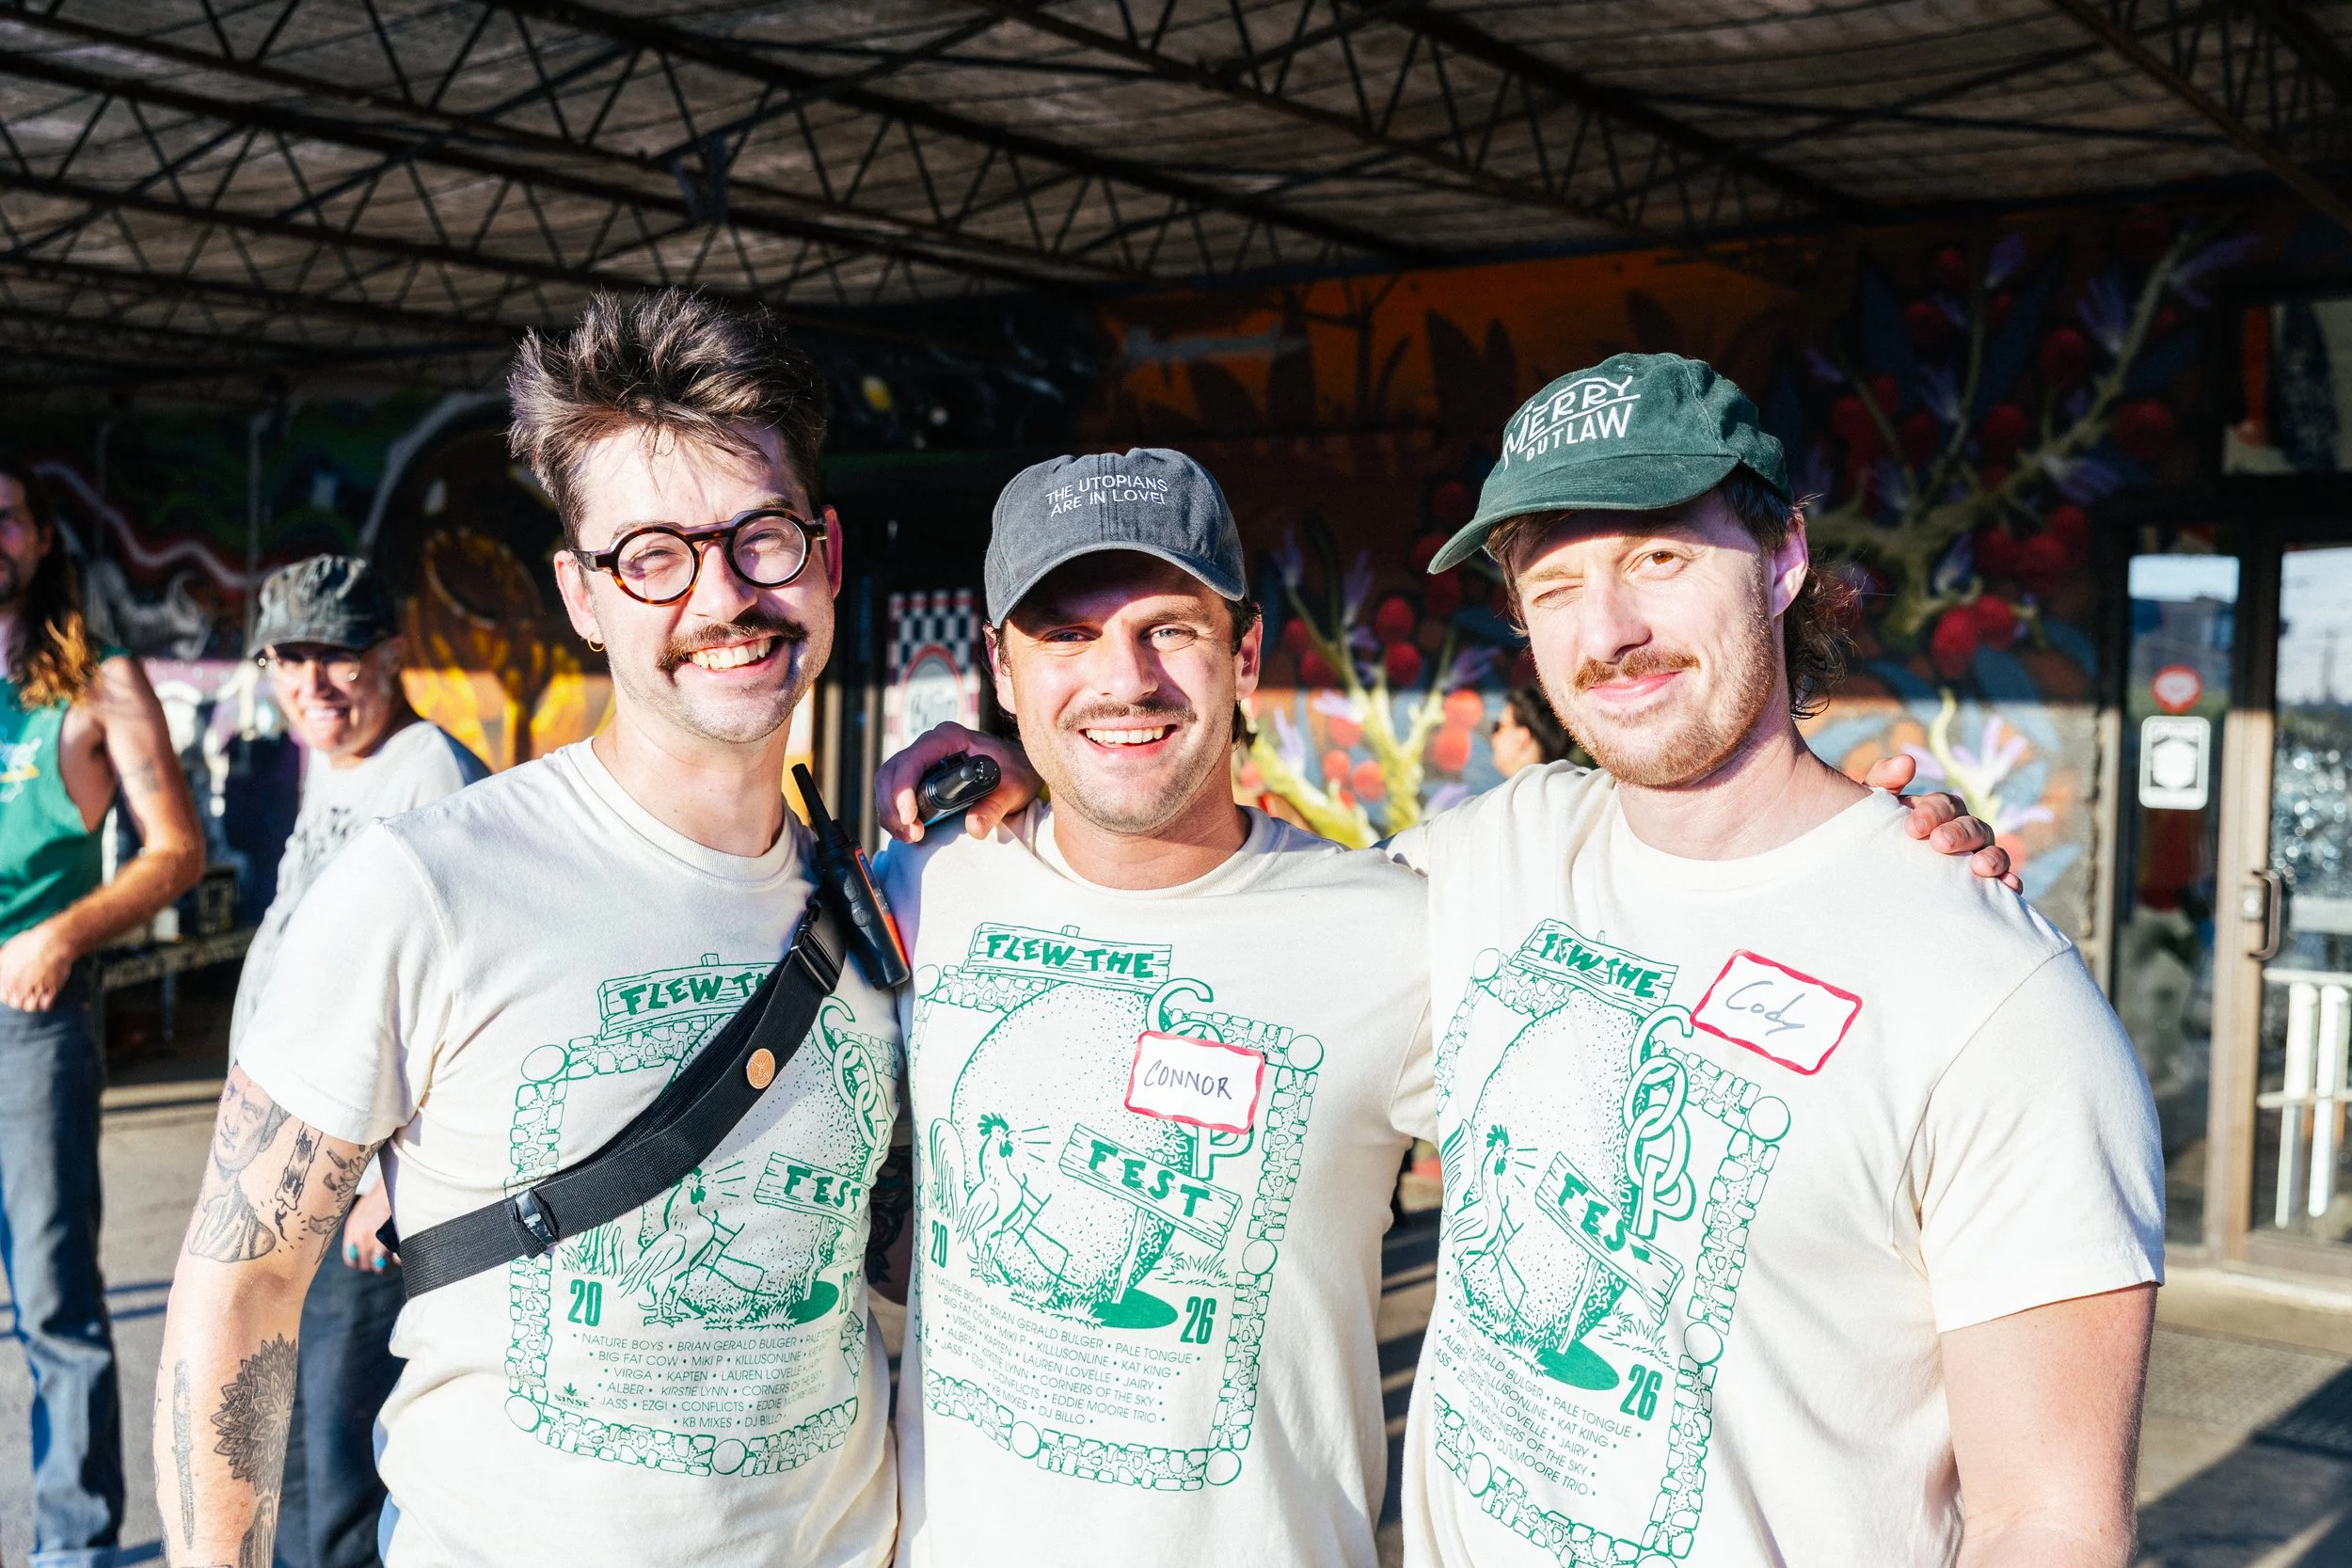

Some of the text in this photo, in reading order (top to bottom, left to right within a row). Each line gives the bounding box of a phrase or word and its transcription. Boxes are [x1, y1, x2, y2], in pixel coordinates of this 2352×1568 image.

[1502, 375, 1634, 469] MERRY
[1045, 474, 1168, 505] THE UTOPIANS
[1050, 496, 1083, 517] ARE
[1089, 490, 1105, 505] IN
[987, 933, 1154, 979] FLEW THE
[1606, 958, 1662, 998] THE
[619, 975, 724, 1016] FLEW
[1725, 980, 1806, 1037] Cody
[1143, 1058, 1232, 1101] CONNOR
[783, 1164, 862, 1214] FEST
[1088, 1138, 1212, 1218] FEST
[930, 1219, 948, 1269] 20
[567, 1278, 603, 1327] 20
[934, 1274, 1193, 1365] NATURE BOYS BRIAN GERALD BULGER PALE TONGUE
[1179, 1295, 1217, 1345] 26
[581, 1332, 628, 1349] NATURE
[631, 1339, 664, 1352] BOYS
[676, 1340, 712, 1352] BRIAN
[713, 1338, 757, 1352] GERALD
[758, 1337, 798, 1349] BULGER
[598, 1350, 620, 1363] BIG
[623, 1353, 644, 1365] FAT
[645, 1354, 679, 1367] COW
[691, 1354, 713, 1367] MIKI
[715, 1354, 723, 1365] P
[735, 1351, 802, 1366] KILLUSONLINE
[943, 1293, 1172, 1379] BIG FAT COW MIKI P KILLUSONLINE KAT KING
[952, 1313, 1154, 1391] VIRGA KAPTEN LAUREN LOVELLE JAIRY
[606, 1382, 645, 1395] ALBER
[660, 1386, 698, 1398] KIRSTIE
[700, 1386, 729, 1398] LYNN
[741, 1382, 790, 1397] CORNERS
[613, 1365, 802, 1382] VIRGA KAPTEN LAUREN LOVELLE
[941, 1339, 963, 1356] JASS
[993, 1369, 1041, 1400] CONFLICTS
[1051, 1393, 1085, 1410] EDDIE
[1086, 1400, 1130, 1418] MOORE
[1132, 1409, 1157, 1423] TRIO
[946, 1326, 974, 1346] ALBER
[1004, 1361, 1029, 1380] LYNN
[1040, 1374, 1093, 1396] CORNERS
[1095, 1386, 1112, 1399] OF
[1113, 1388, 1134, 1404] THE
[1135, 1395, 1155, 1408] SKY
[554, 1393, 591, 1409] SINSE
[599, 1396, 629, 1410] JASS
[642, 1400, 668, 1412] EZGI
[681, 1401, 745, 1413] CONFLICTS
[756, 1397, 783, 1412] EDDIE
[1002, 1389, 1028, 1411] MIXES
[1038, 1405, 1053, 1418] DJ
[1055, 1409, 1086, 1425] BILLO
[1505, 1369, 1544, 1400] BULGER
[1552, 1396, 1581, 1418] PALE
[1581, 1409, 1632, 1438] TONGUE
[1619, 1363, 1663, 1421] 26
[682, 1413, 783, 1429] KB MIXES DJ BILLO
[1500, 1401, 1590, 1458] LOVELLE JAIRY
[1556, 1417, 1579, 1435] KAT
[1579, 1426, 1609, 1448] KING
[1514, 1448, 1561, 1483] MOORE
[1561, 1475, 1588, 1496] TRIO
[1526, 1437, 1546, 1453] OF
[1545, 1448, 1567, 1468] THE
[1567, 1459, 1588, 1476] SKY
